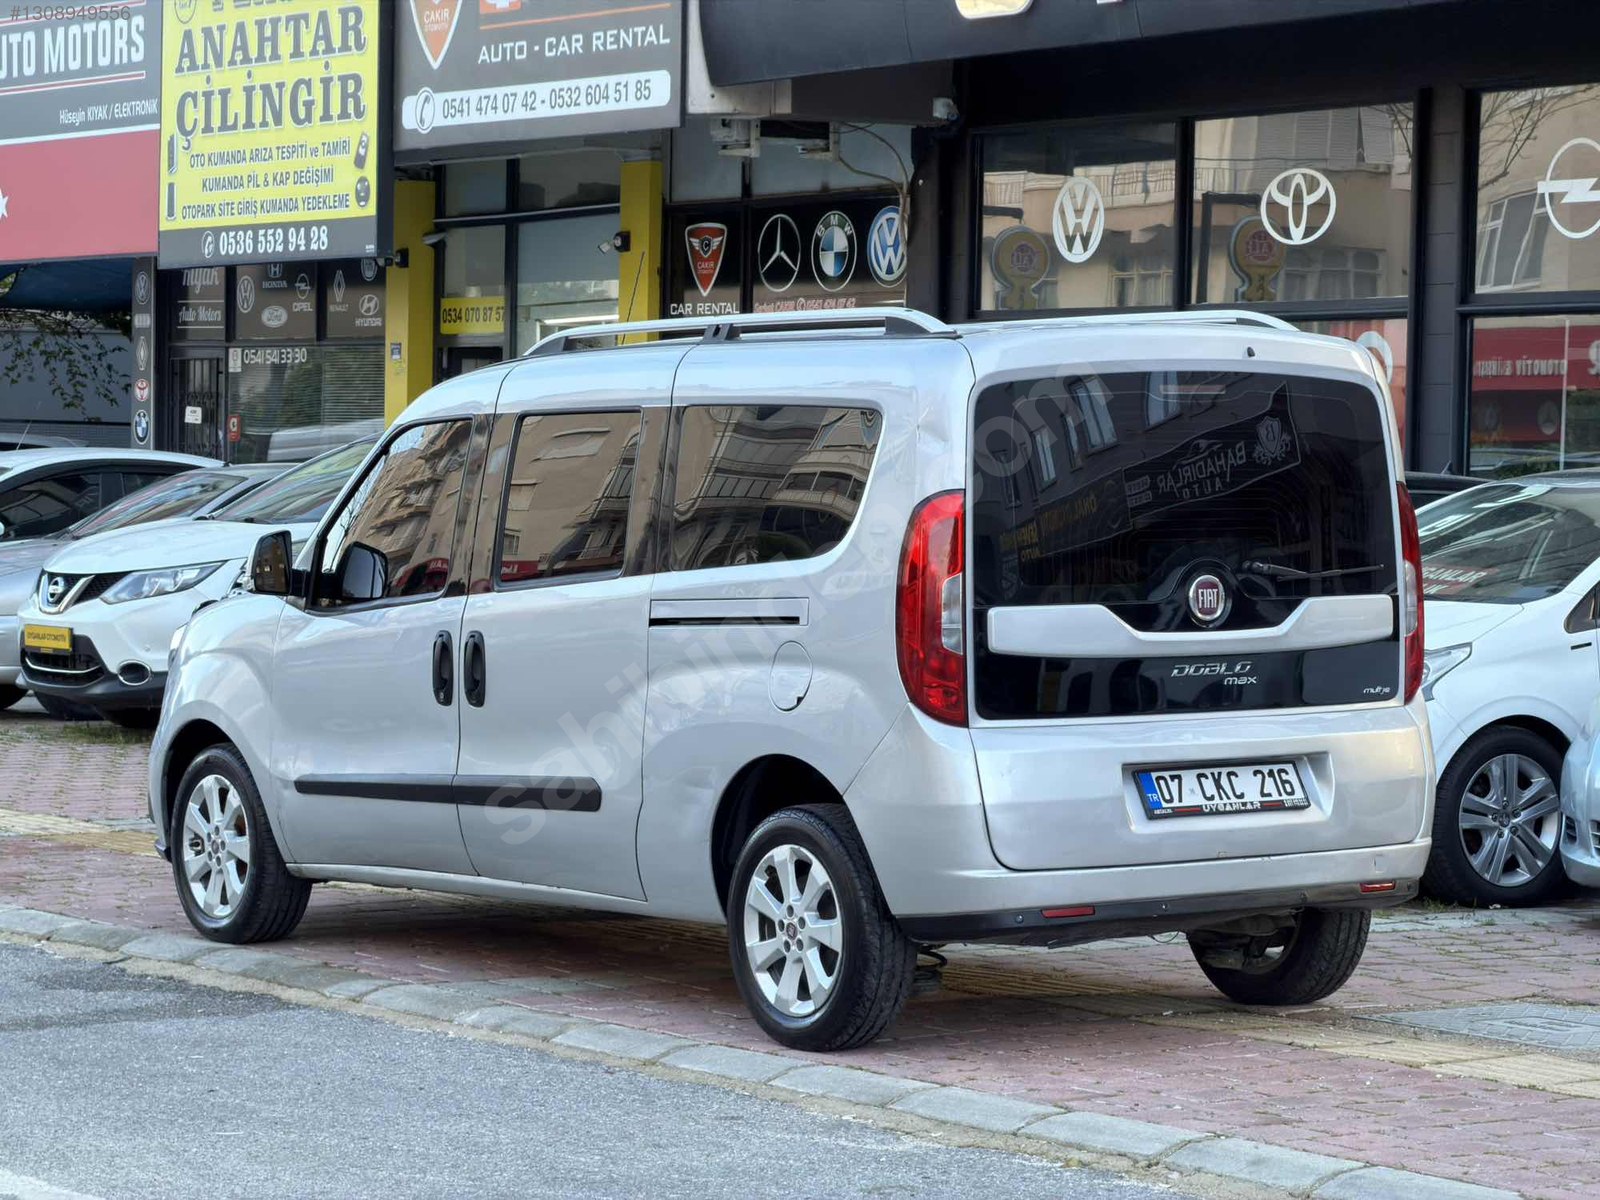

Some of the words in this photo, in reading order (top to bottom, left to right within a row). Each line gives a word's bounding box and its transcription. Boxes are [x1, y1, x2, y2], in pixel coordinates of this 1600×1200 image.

[44, 15, 145, 74] MOTORS
[175, 6, 366, 75] ANAHTAR
[478, 41, 527, 64] AUTO
[545, 34, 583, 57] CAR
[592, 24, 670, 51] RENTAL
[176, 60, 366, 150] ÇİLİNGİR
[442, 98, 471, 119] 0541
[475, 95, 498, 116] 474
[501, 92, 518, 113] 07
[521, 90, 537, 112] 42
[549, 86, 581, 109] 0532
[585, 84, 610, 106] 604
[614, 80, 629, 103] 51
[634, 79, 652, 101] 85
[59, 107, 86, 126] Hüseyin
[87, 103, 108, 122] KIYAK
[189, 152, 206, 169] OTO
[207, 149, 247, 167] KUMANDA
[249, 147, 274, 163] ARIZA
[276, 141, 308, 161] TESPİTİ
[310, 147, 319, 158] ve
[202, 173, 244, 193] KUMANDA
[247, 171, 261, 189] PİL
[263, 174, 270, 186] &
[272, 172, 290, 187] KAP
[181, 203, 216, 220] OTOPARK
[218, 199, 235, 217] SİTE
[237, 196, 258, 219] GİRİŞ
[260, 197, 299, 214] KUMANDA
[302, 193, 350, 212] YEDEKLEME
[219, 231, 253, 256] 0536
[257, 228, 284, 254] 552
[288, 227, 306, 251] 94
[310, 225, 329, 250] 28
[262, 280, 288, 289] HONDA
[292, 302, 313, 312] OPEL
[442, 307, 463, 324] 0534
[464, 307, 481, 322] 070
[482, 306, 493, 321] 87
[670, 303, 693, 316] CAR
[696, 302, 741, 315] RENTAL
[243, 349, 264, 365] 0541
[281, 348, 293, 364] 33
[294, 347, 308, 363] 30
[1198, 588, 1218, 609] FIAT
[1171, 661, 1252, 677] DOBLO
[1224, 676, 1257, 685] max
[1155, 774, 1183, 804] 07
[1196, 770, 1245, 801] CKC
[1253, 768, 1296, 798] 216
[1148, 793, 1159, 803] TR
